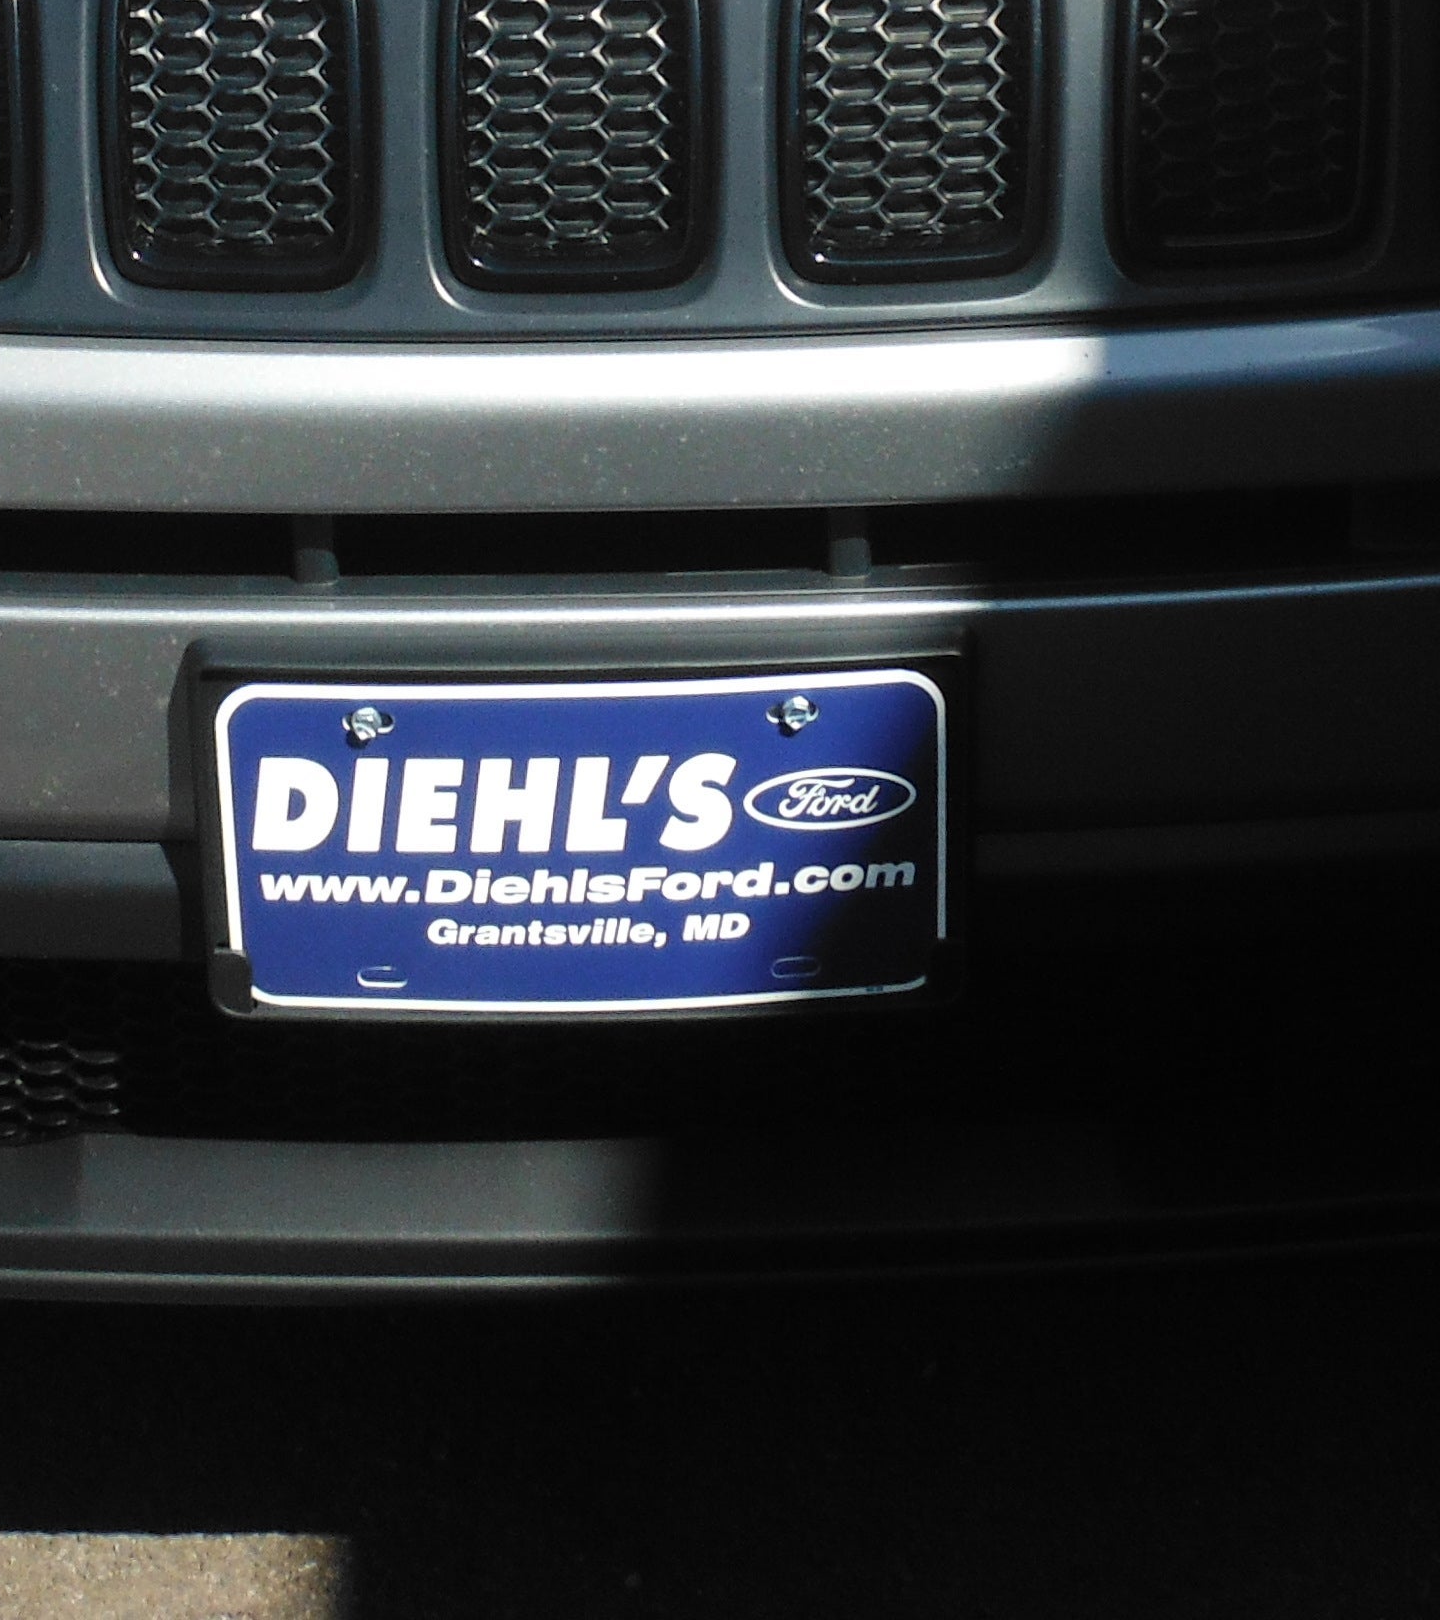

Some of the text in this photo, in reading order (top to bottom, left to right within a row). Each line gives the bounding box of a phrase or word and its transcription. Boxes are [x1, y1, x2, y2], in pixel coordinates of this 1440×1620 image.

[251, 753, 738, 854] DIEHL'S
[777, 775, 881, 818] Ford
[259, 859, 915, 905] www.DiehlsFord.com
[426, 913, 751, 949] Grantsville, MD
